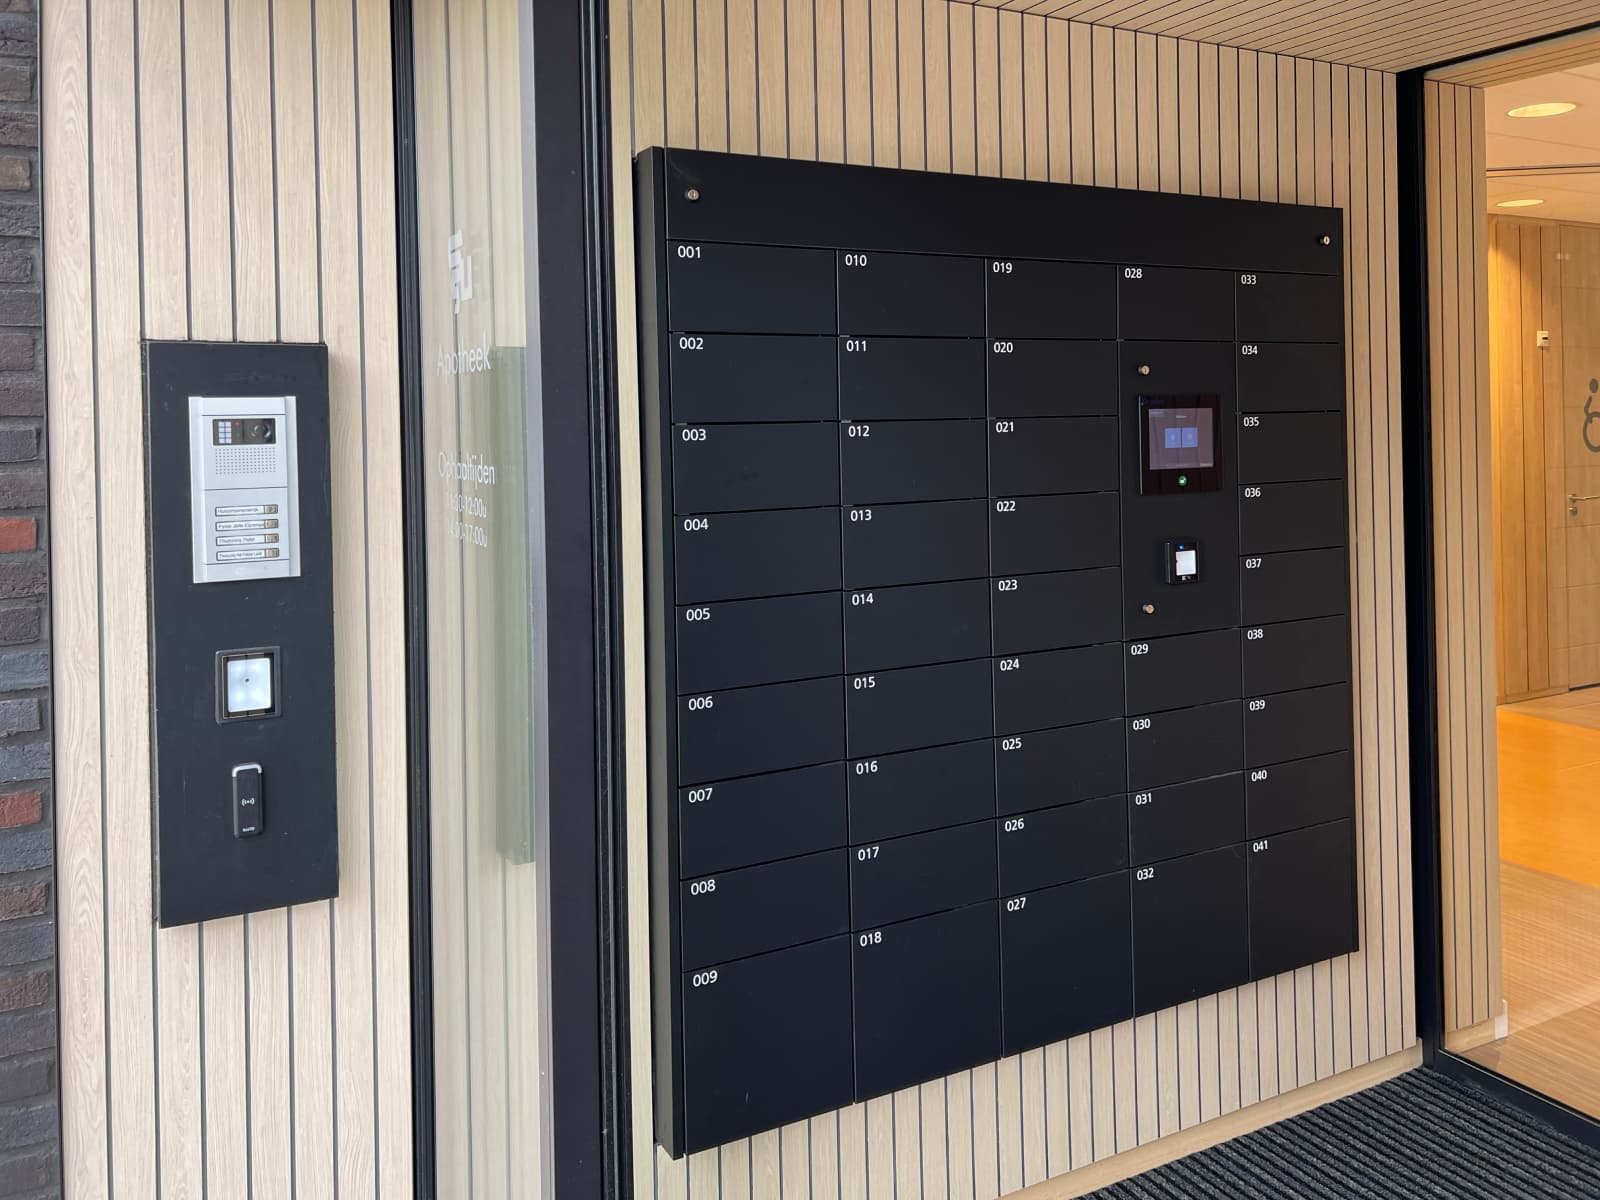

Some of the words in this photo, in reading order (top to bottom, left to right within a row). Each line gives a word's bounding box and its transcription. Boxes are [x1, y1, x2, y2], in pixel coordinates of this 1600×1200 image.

[677, 245, 702, 260] 001
[844, 253, 868, 267] 010
[992, 261, 1013, 274] 019
[1124, 267, 1143, 279] 028
[1240, 274, 1257, 285] 033
[679, 336, 704, 350] 002
[845, 339, 868, 353] 011
[993, 341, 1014, 354] 020
[1241, 344, 1258, 355] 034
[437, 332, 491, 381] Apotheek
[995, 420, 1014, 434] 021
[1243, 416, 1260, 427] 035
[681, 428, 707, 442] 003
[848, 425, 870, 438] 012
[439, 451, 495, 488] Ophaaltijden
[1244, 487, 1262, 498] 036
[996, 500, 1016, 513] 022
[850, 508, 872, 522] 013
[683, 517, 709, 532] 004
[1245, 558, 1262, 569] 037
[998, 579, 1018, 592] 023
[851, 592, 874, 606] 014
[685, 607, 711, 622] 005
[1247, 628, 1264, 640] 038
[1130, 643, 1149, 656] 029
[999, 658, 1020, 672] 024
[853, 675, 876, 690] 015
[687, 695, 714, 712] 006
[1249, 699, 1266, 712] 039
[1132, 718, 1151, 731] 030
[1002, 737, 1022, 751] 025
[855, 760, 879, 775] 016
[1251, 769, 1268, 782] 040
[688, 787, 713, 803] 007
[1135, 792, 1152, 806] 031
[1004, 817, 1025, 832] 026
[857, 845, 880, 861] 017
[1252, 839, 1268, 853] 041
[1136, 867, 1154, 881] 032
[690, 879, 716, 896] 008
[1006, 896, 1027, 912] 027
[859, 931, 882, 947] 018
[692, 969, 718, 988] 009
